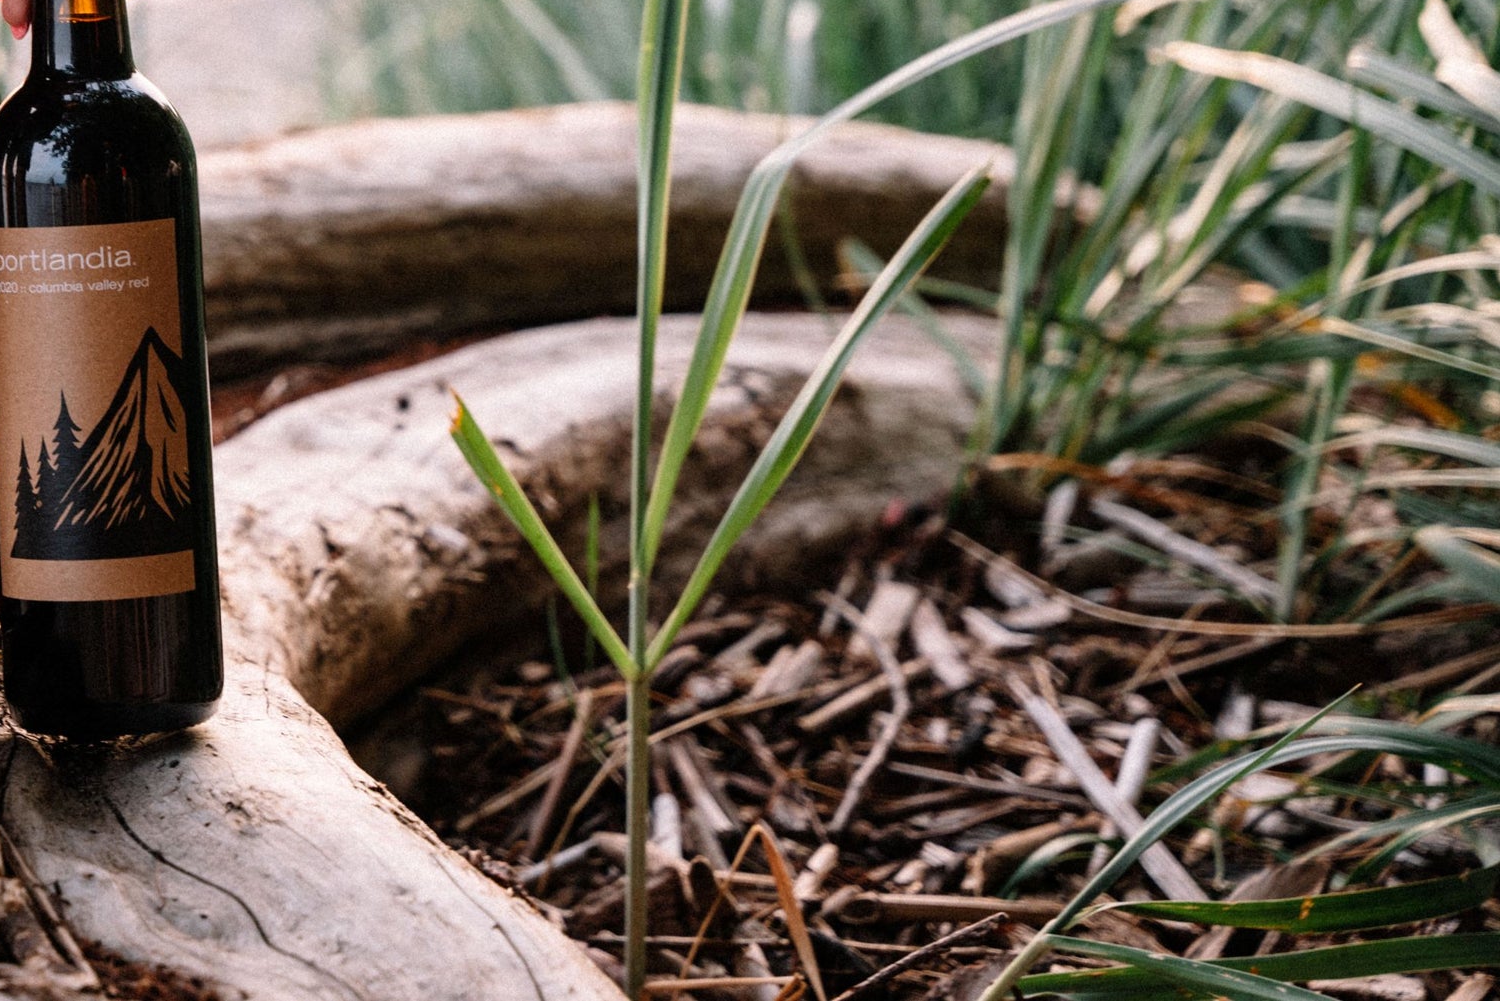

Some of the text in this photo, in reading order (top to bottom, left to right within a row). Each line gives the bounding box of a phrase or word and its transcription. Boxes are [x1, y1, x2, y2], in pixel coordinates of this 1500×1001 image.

[29, 281, 83, 293] columbia
[88, 279, 125, 292] valley
[129, 276, 150, 288] red
